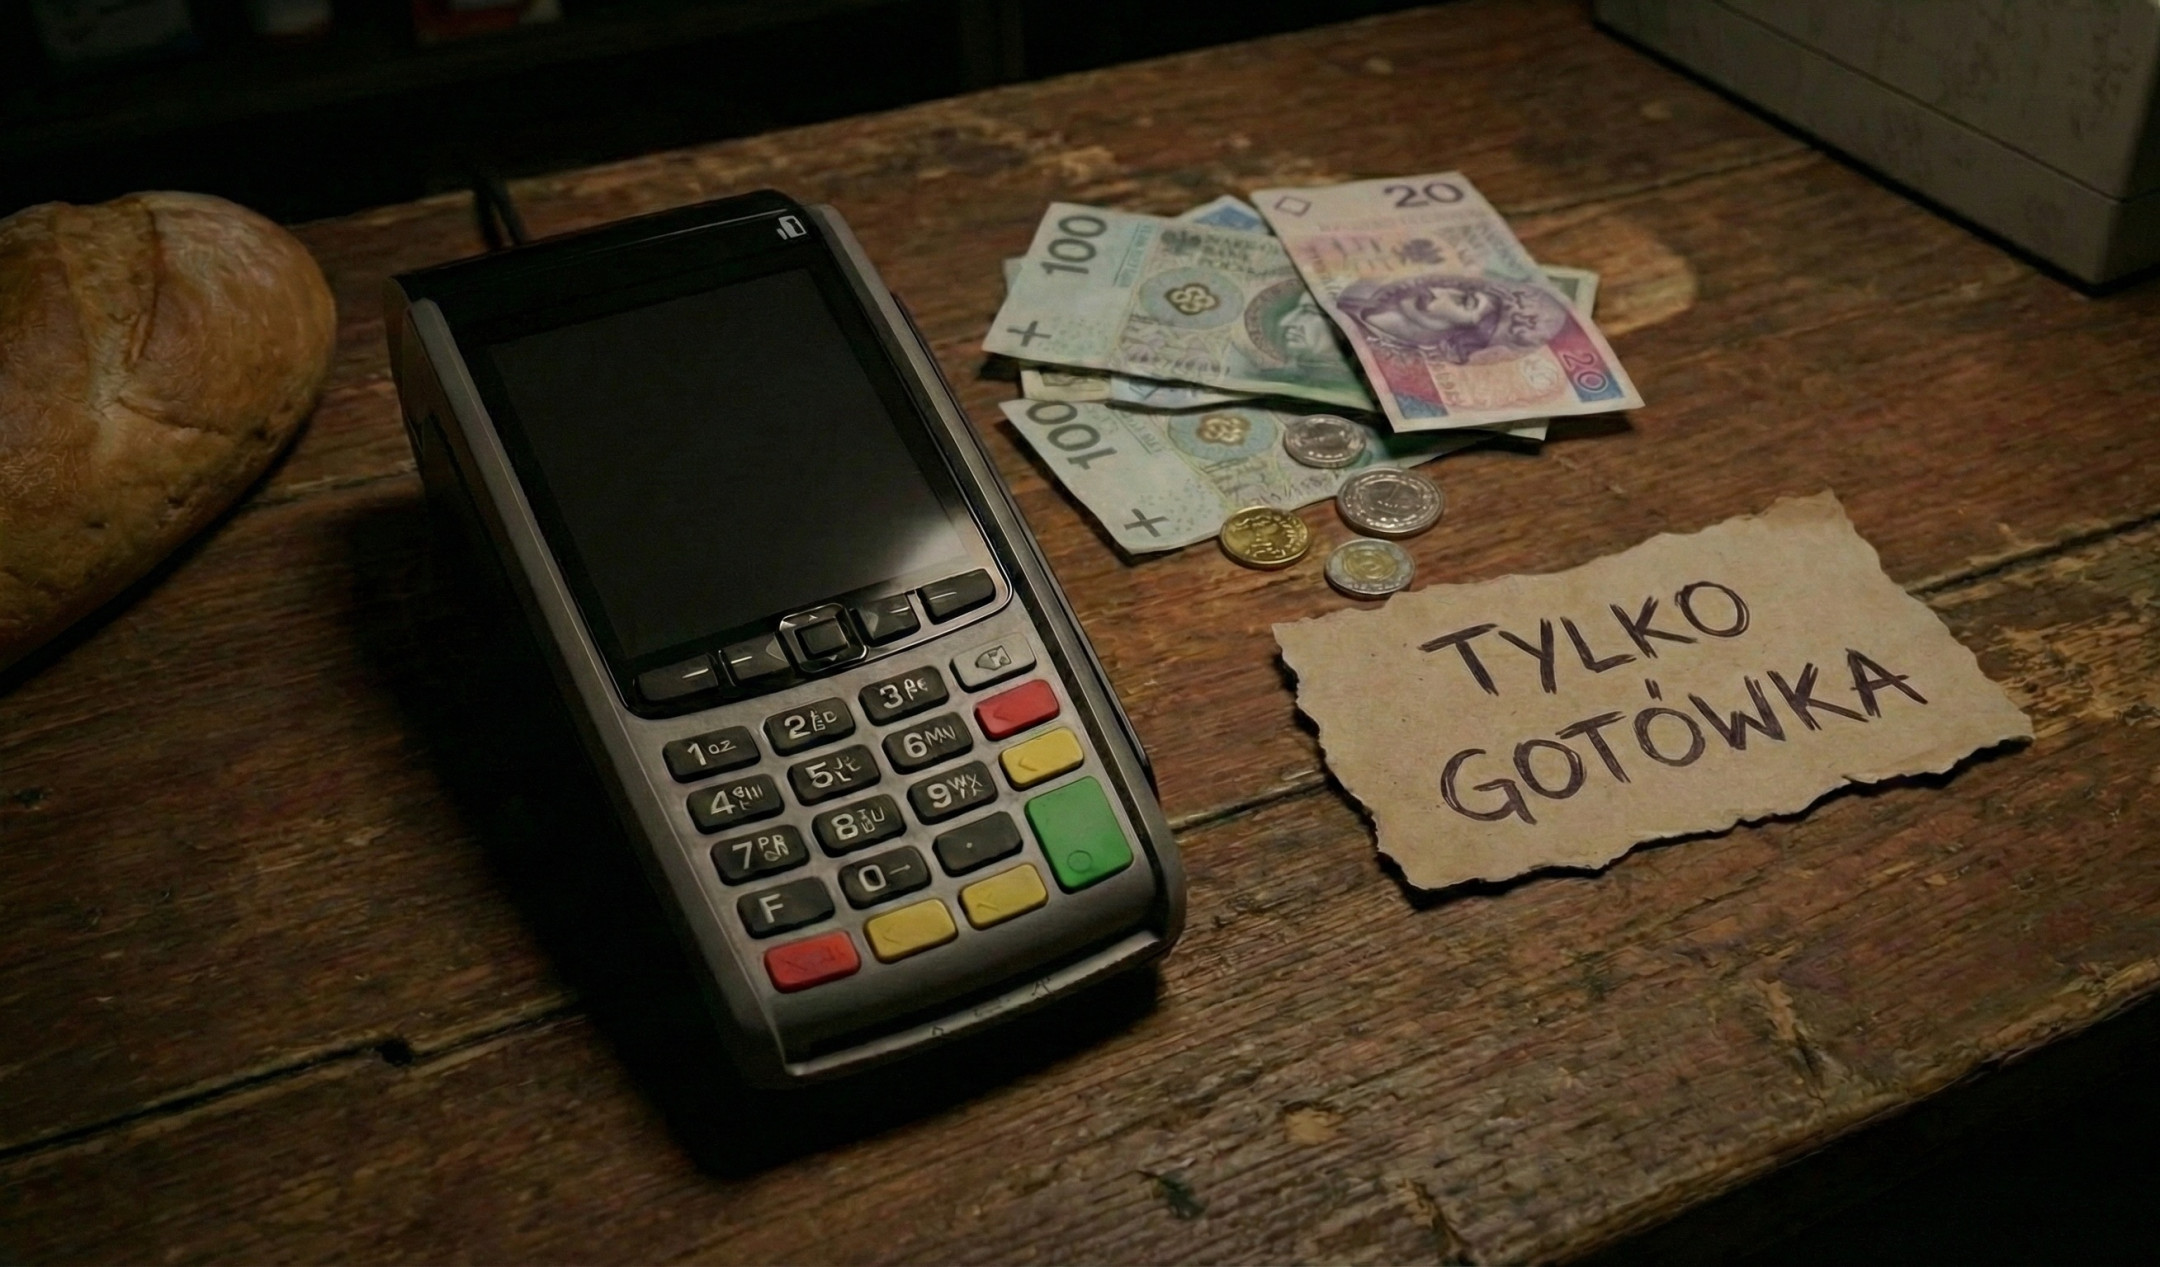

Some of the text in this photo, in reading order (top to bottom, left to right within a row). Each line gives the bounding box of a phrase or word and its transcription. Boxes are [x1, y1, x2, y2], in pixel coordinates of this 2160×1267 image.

[1384, 181, 1464, 208] 20
[1040, 214, 1107, 275] 100
[1562, 350, 1609, 394] 20
[1026, 400, 1118, 470] 100
[1418, 580, 1750, 696] TYLKO
[880, 684, 903, 709] 3
[784, 715, 811, 740] 2
[1440, 649, 1928, 825] GOTÓWKA
[687, 743, 707, 766] 1
[903, 732, 928, 758] 6
[805, 762, 833, 788] 5
[711, 790, 735, 815] 4
[927, 783, 952, 808] 9
[831, 813, 859, 840] 8
[732, 841, 752, 870] 7
[759, 893, 784, 924] F
